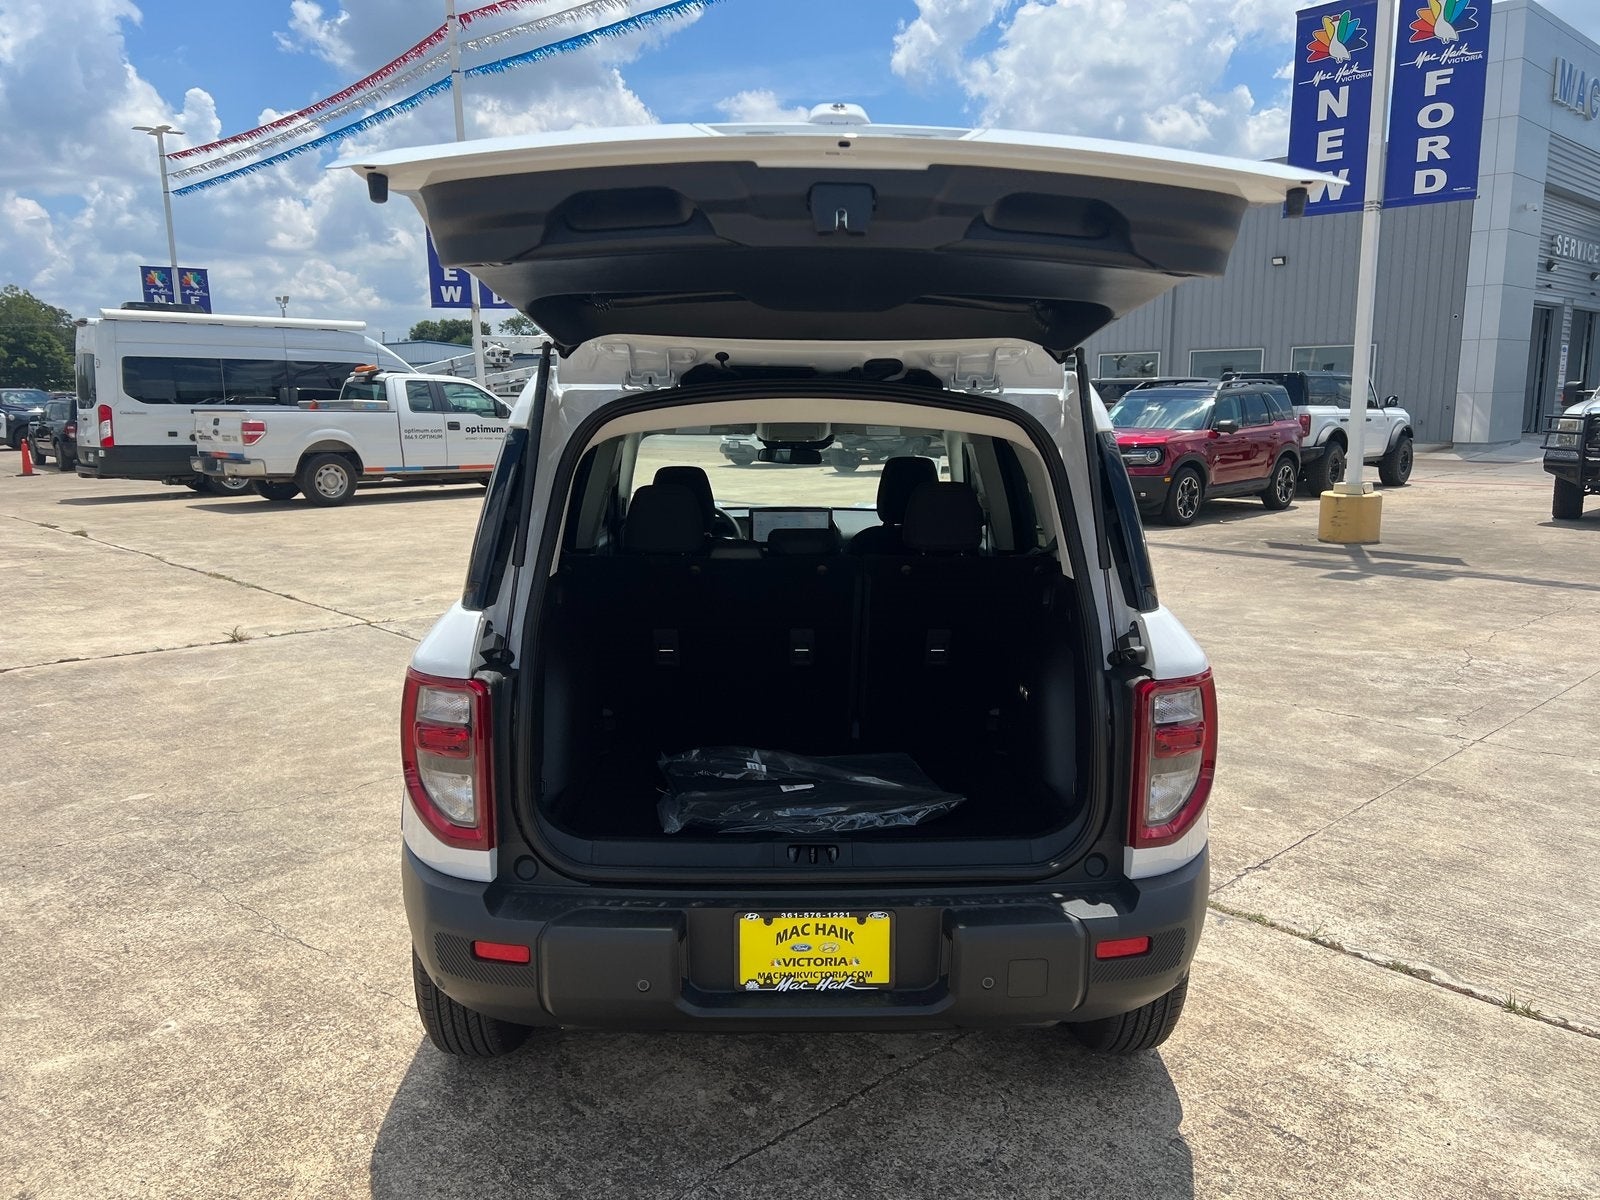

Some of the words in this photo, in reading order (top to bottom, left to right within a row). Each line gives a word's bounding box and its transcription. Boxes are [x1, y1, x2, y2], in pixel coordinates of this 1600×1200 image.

[1411, 51, 1439, 69] Mac
[1439, 43, 1468, 65] Haik
[1447, 53, 1482, 65] VICTORIA
[1310, 70, 1334, 87] Mac
[1334, 62, 1360, 83] Haik
[1341, 70, 1373, 83] VICTORIA
[1556, 57, 1600, 120] MAC
[1413, 68, 1455, 195] FORD
[1308, 86, 1349, 203] NEW
[1556, 234, 1600, 263] SERVICE
[776, 923, 810, 946] MAC
[815, 923, 855, 945] HAIK
[782, 957, 848, 967] VICTORIA
[775, 976, 809, 992] Mac
[815, 976, 857, 992] Haik
